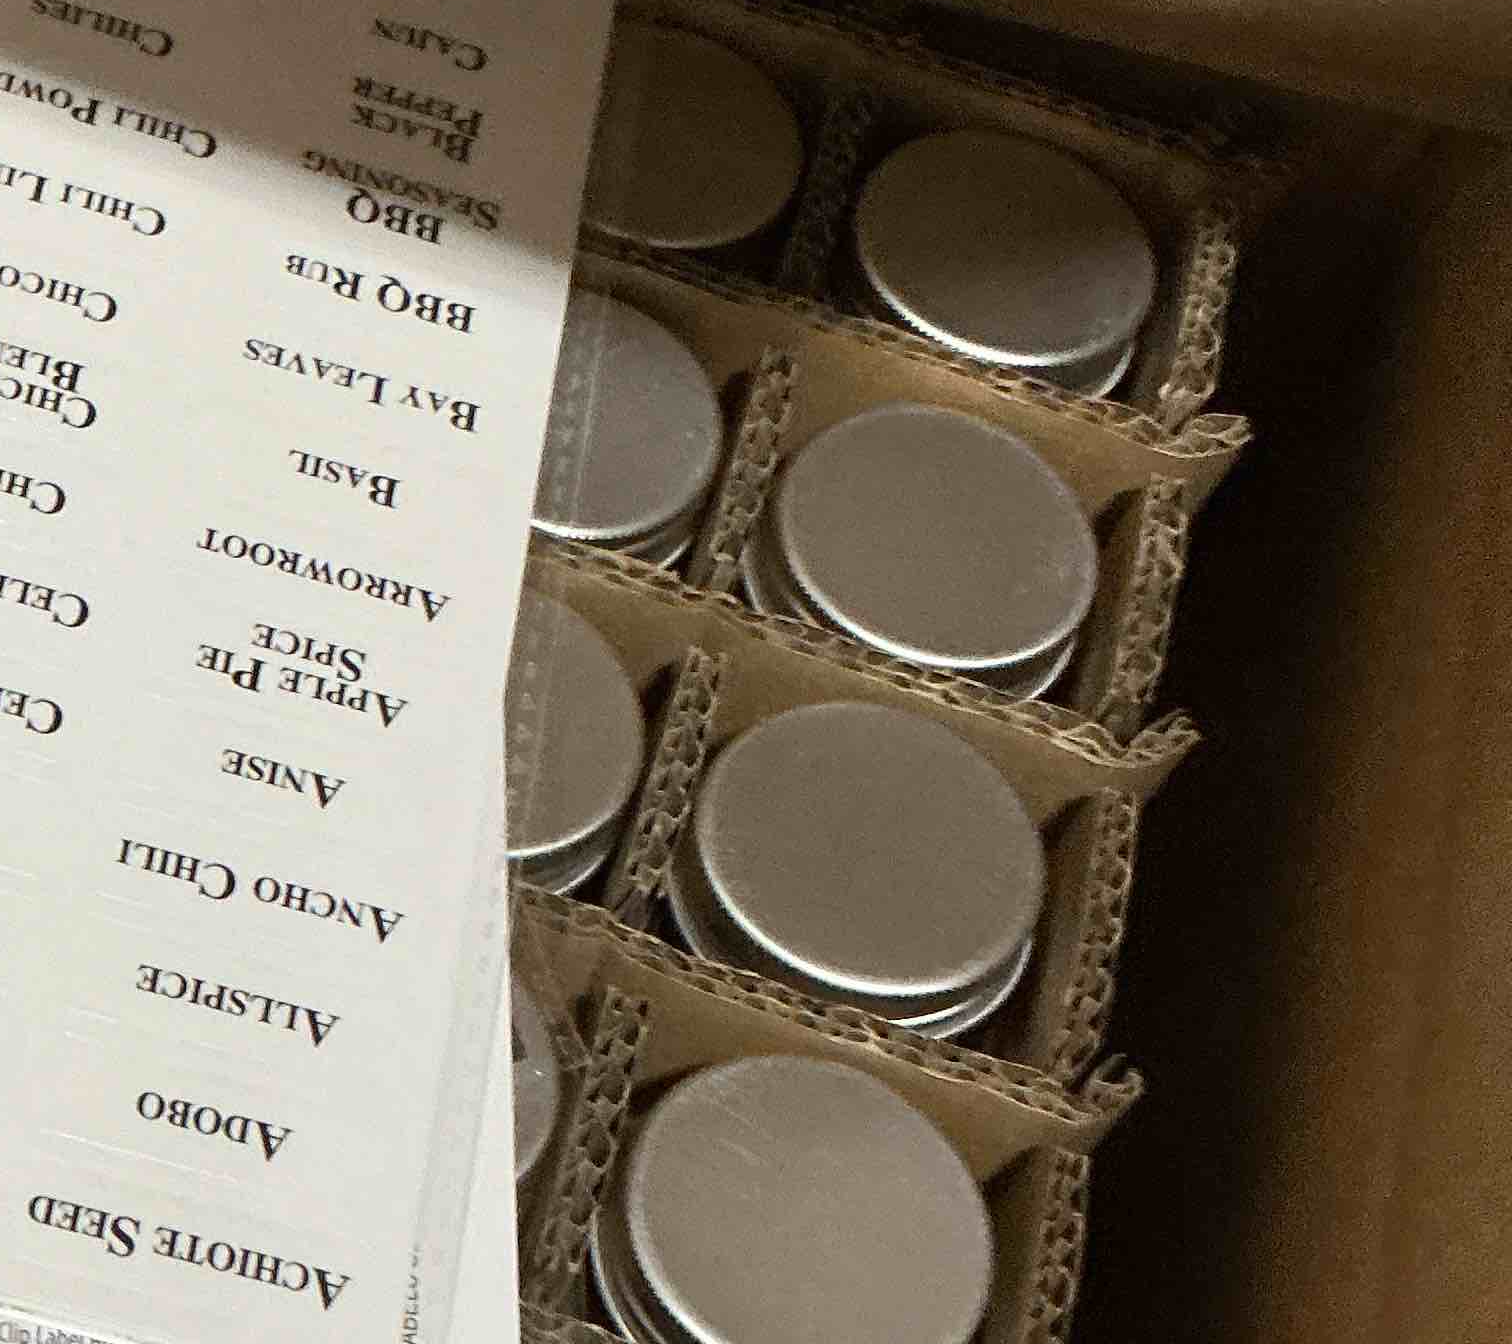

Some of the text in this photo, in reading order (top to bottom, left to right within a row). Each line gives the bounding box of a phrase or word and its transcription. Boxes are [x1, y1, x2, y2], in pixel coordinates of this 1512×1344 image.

[370, 17, 488, 72] CAJUN
[112, 106, 217, 159] CHILI
[351, 103, 476, 163] BLACK
[353, 75, 485, 139] PEPPER
[60, 186, 168, 237] CHILI
[301, 150, 501, 232] SEASONING
[346, 188, 446, 245] BBQ
[286, 253, 477, 335] BBQ RUB
[243, 338, 482, 434] BAY LEAVES
[289, 449, 402, 509] BASIL
[196, 528, 453, 623] ARROWROOT
[195, 643, 409, 728] APPLE PIE
[250, 623, 367, 682] SPICE
[221, 747, 347, 809] ANISE
[116, 838, 409, 945] ANCHO CHILI
[135, 963, 342, 1048] ALLSPICE
[136, 1090, 295, 1162] ADOBO
[28, 1194, 352, 1312] ACHIOTE SEED
